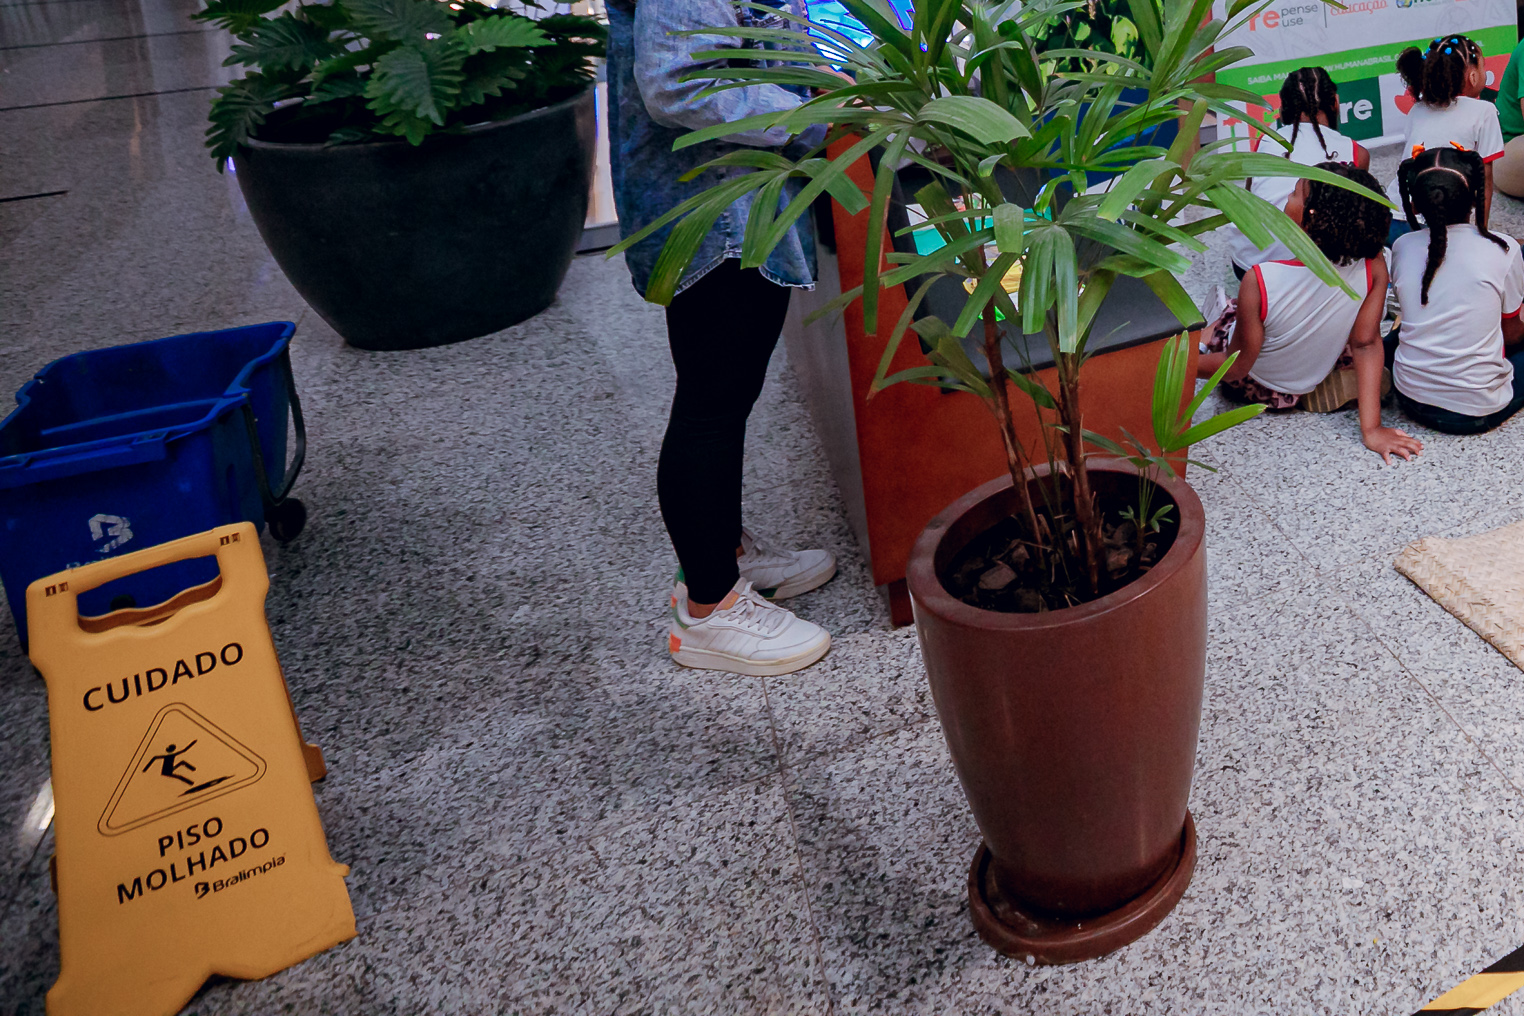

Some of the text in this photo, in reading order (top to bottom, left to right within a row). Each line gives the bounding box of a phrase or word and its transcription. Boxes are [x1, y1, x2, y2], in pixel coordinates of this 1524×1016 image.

[1249, 4, 1318, 32] re pense
[1281, 17, 1304, 27] use
[1247, 74, 1273, 85] SAIBA
[1273, 72, 1290, 81] MAI
[1339, 97, 1374, 125] re
[82, 642, 244, 712] CUIDADO
[157, 816, 223, 859] PISO
[115, 827, 270, 905] MOLHADO
[212, 854, 286, 894] Bralimpia
